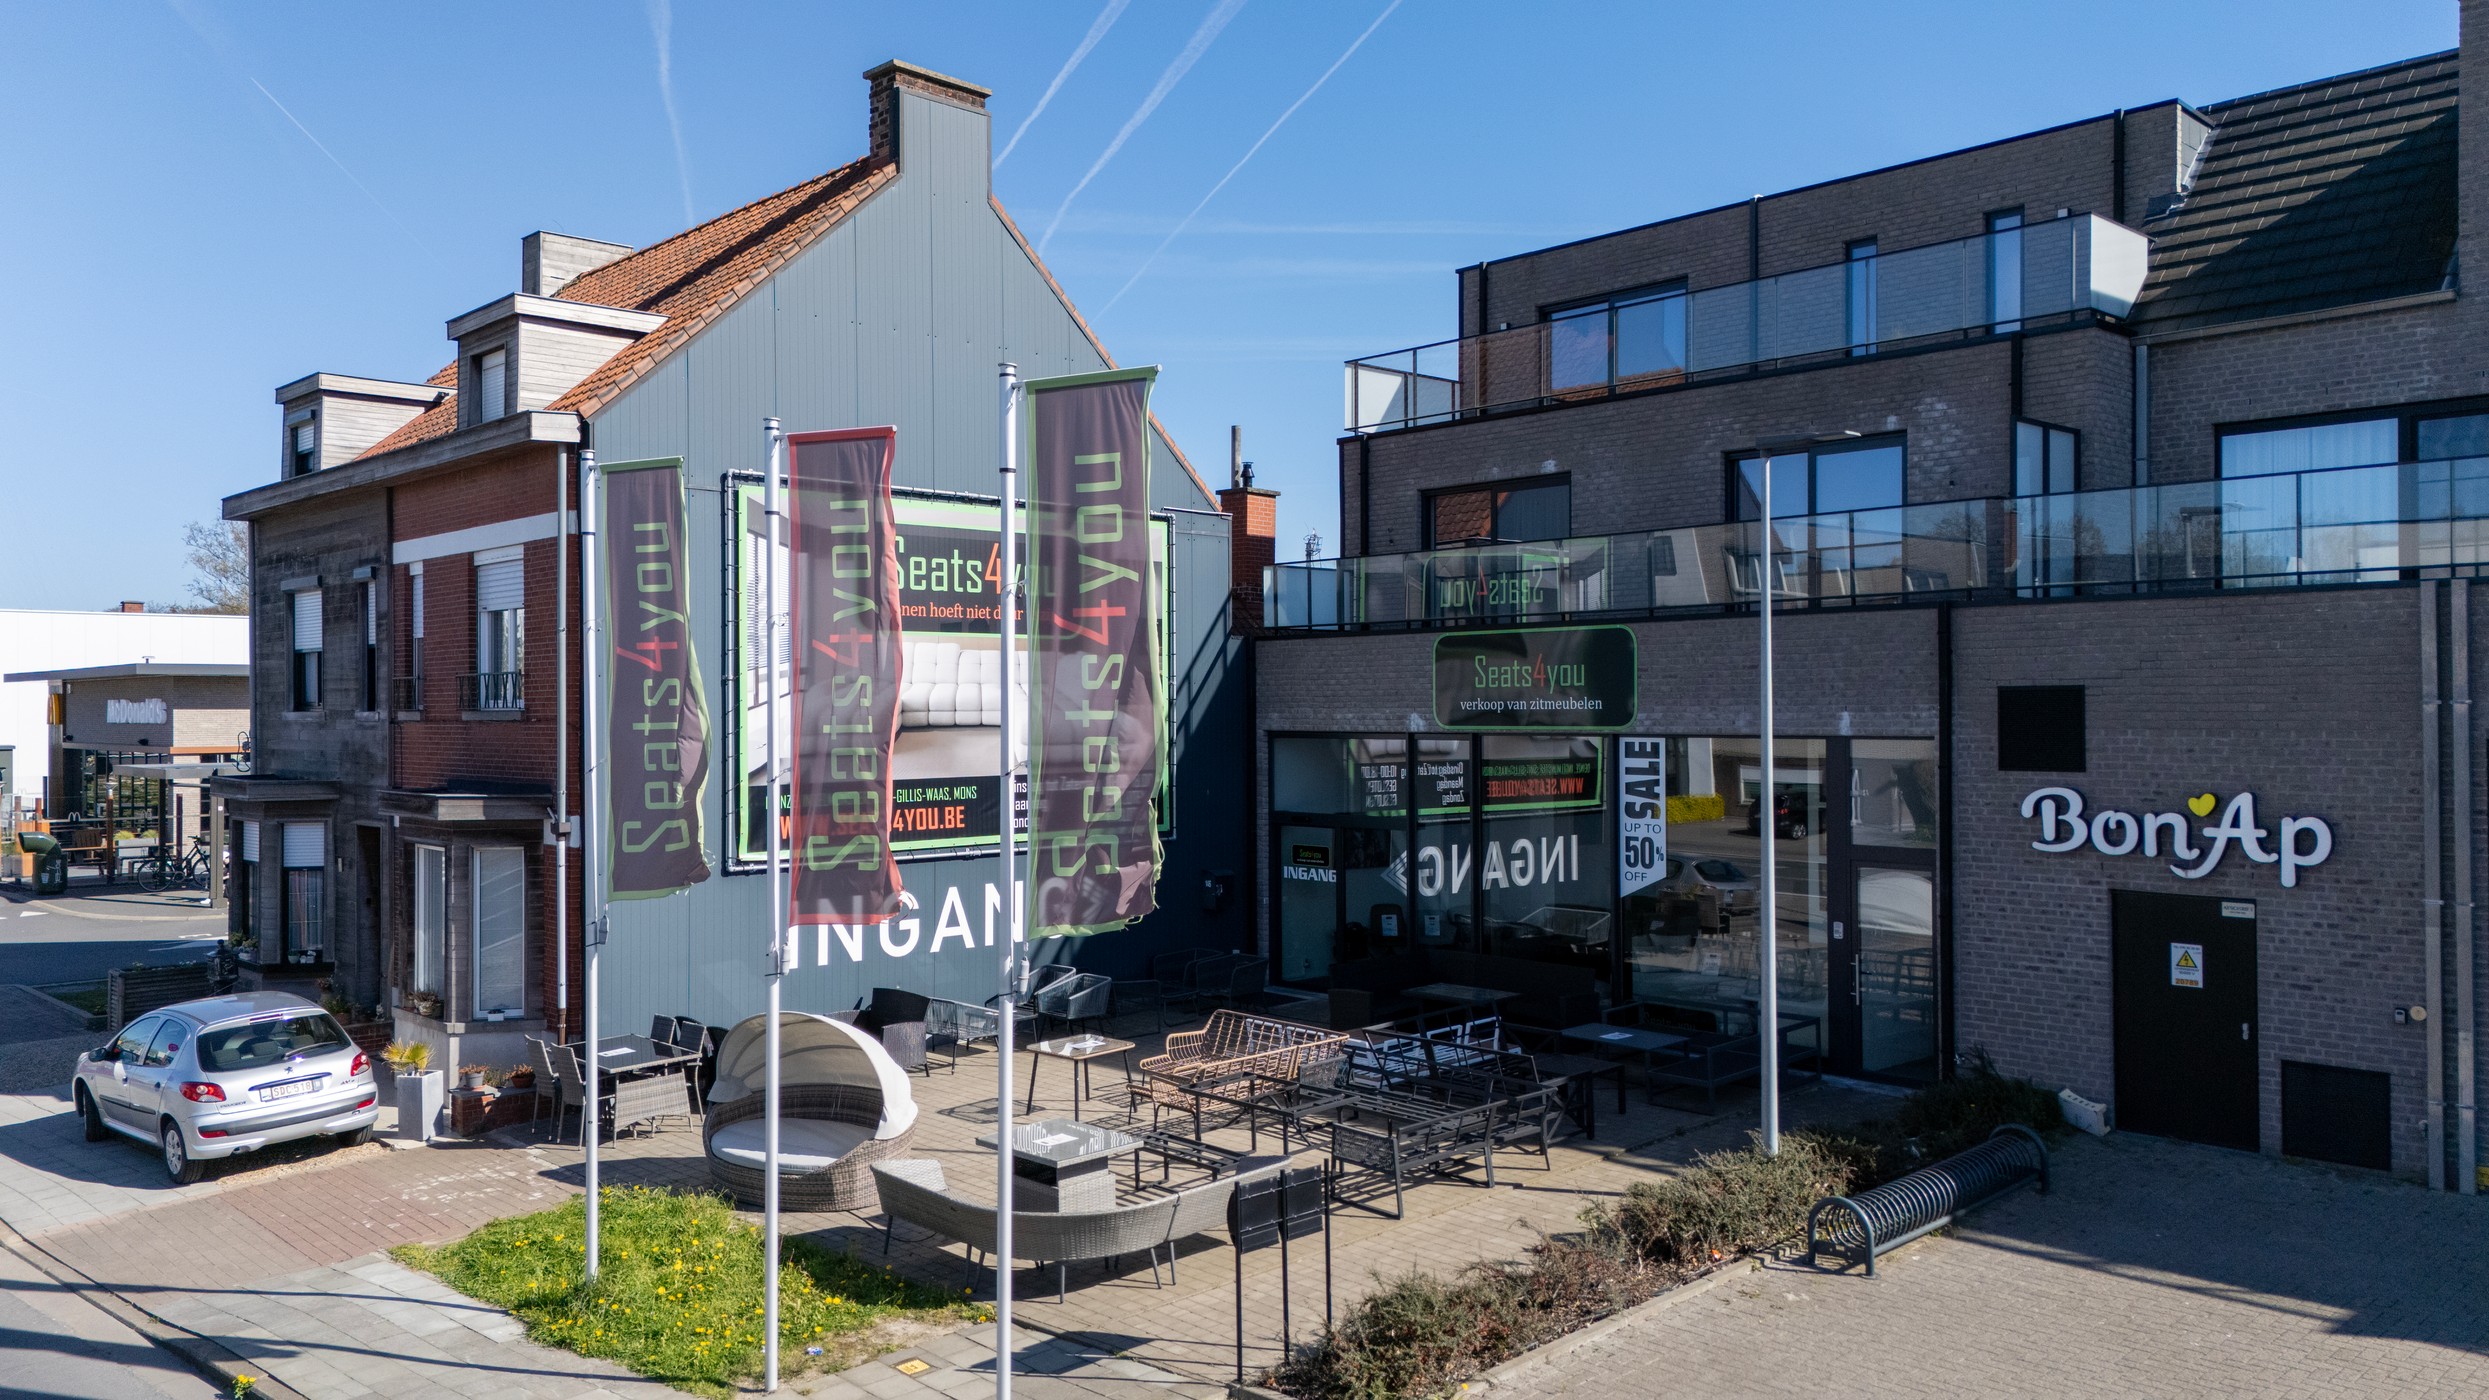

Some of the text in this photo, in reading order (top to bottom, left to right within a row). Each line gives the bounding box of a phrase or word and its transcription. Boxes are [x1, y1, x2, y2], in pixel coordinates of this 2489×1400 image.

[930, 602, 963, 618] hoeft
[967, 604, 992, 619] niet
[993, 604, 1024, 621] dr
[1052, 452, 1139, 877] Seats4you
[1474, 653, 1585, 694] Seats4you
[616, 521, 691, 853] Seats4you
[807, 499, 880, 872] Seats4you
[1460, 697, 1602, 713] verkoop van zitmeubelen
[1625, 741, 1661, 819] SALE
[953, 785, 977, 799] MONS
[1625, 823, 1662, 834] UP TO
[1284, 866, 1336, 883] INGANG
[1625, 871, 1648, 882] OFF
